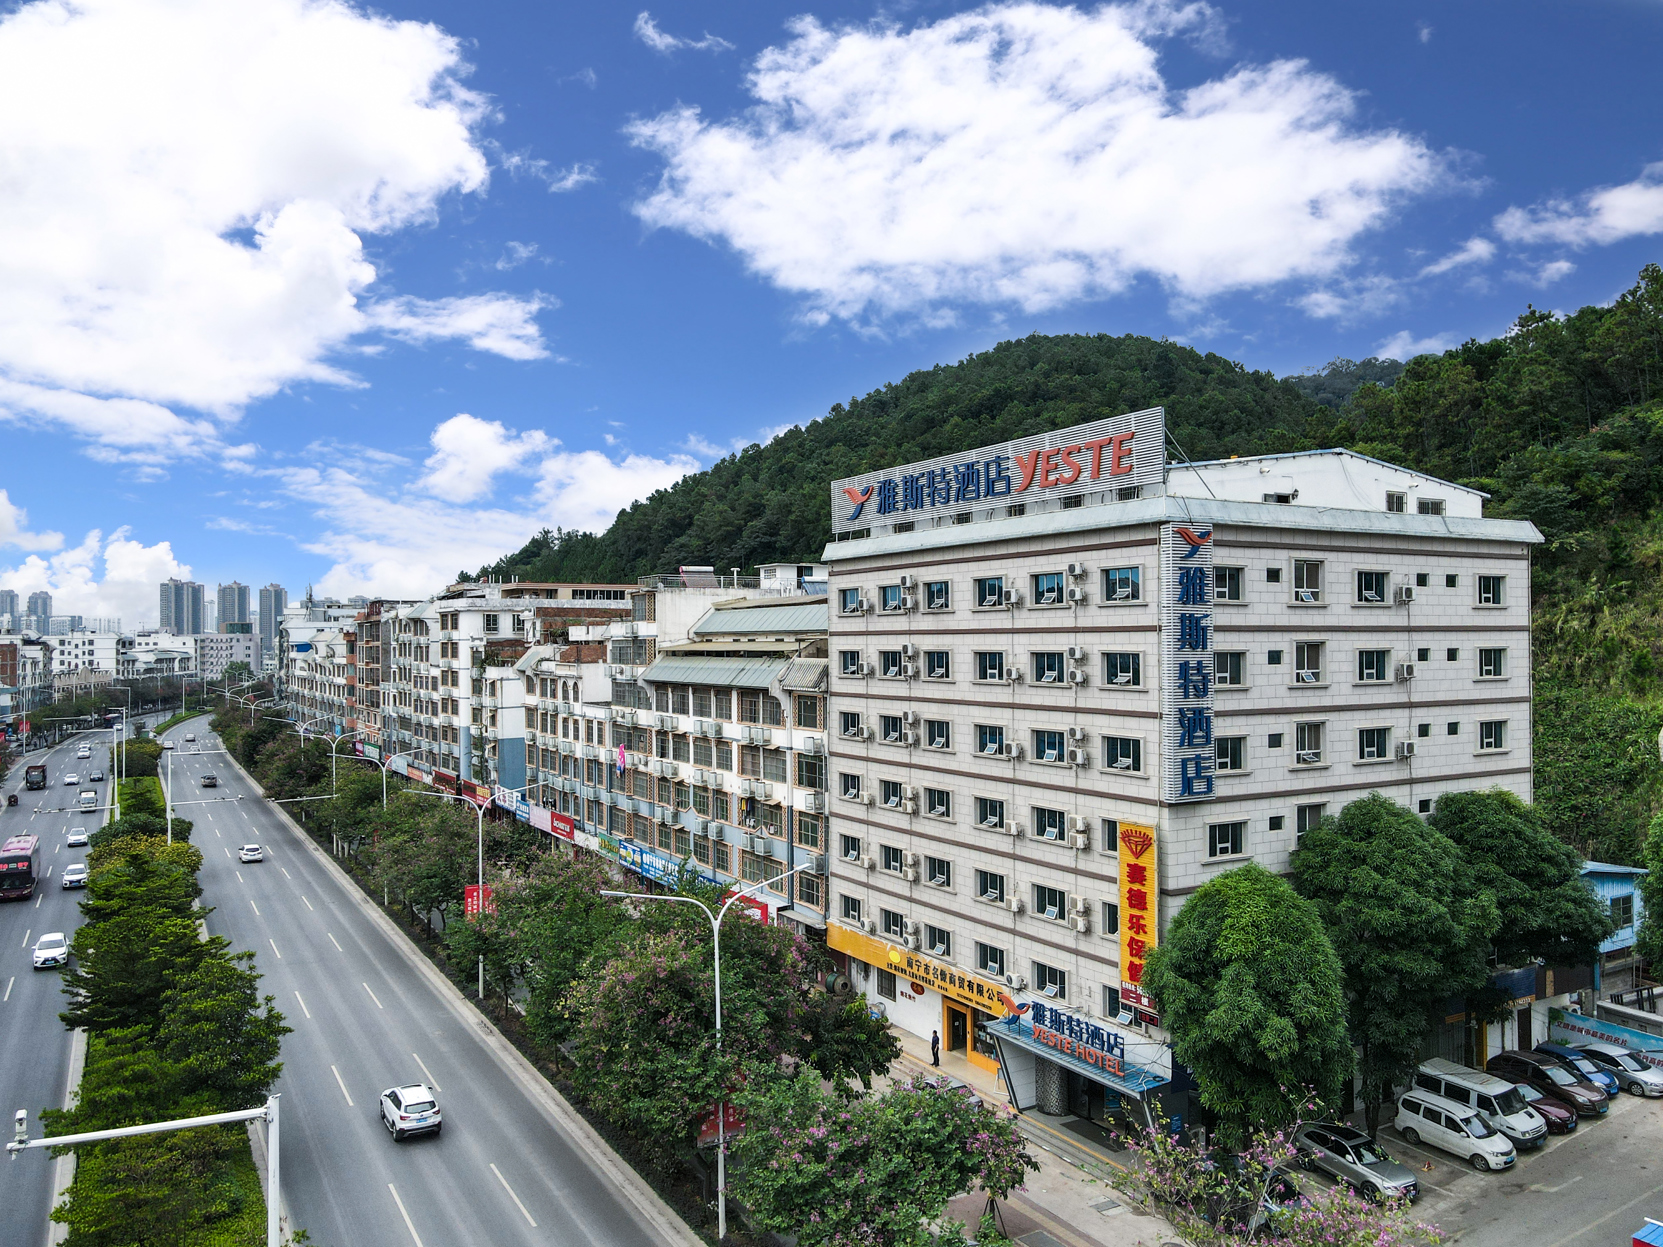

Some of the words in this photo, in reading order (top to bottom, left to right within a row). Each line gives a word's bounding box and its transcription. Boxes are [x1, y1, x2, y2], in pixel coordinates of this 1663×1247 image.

[876, 456, 1011, 515] 雅斯特酒店
[1013, 431, 1135, 493] YESTE
[1177, 566, 1212, 796] 雅斯特酒店
[1031, 1000, 1124, 1059] 雅斯特酒店
[1031, 1024, 1072, 1054] YESTE
[1076, 1042, 1124, 1077] HOTEL
